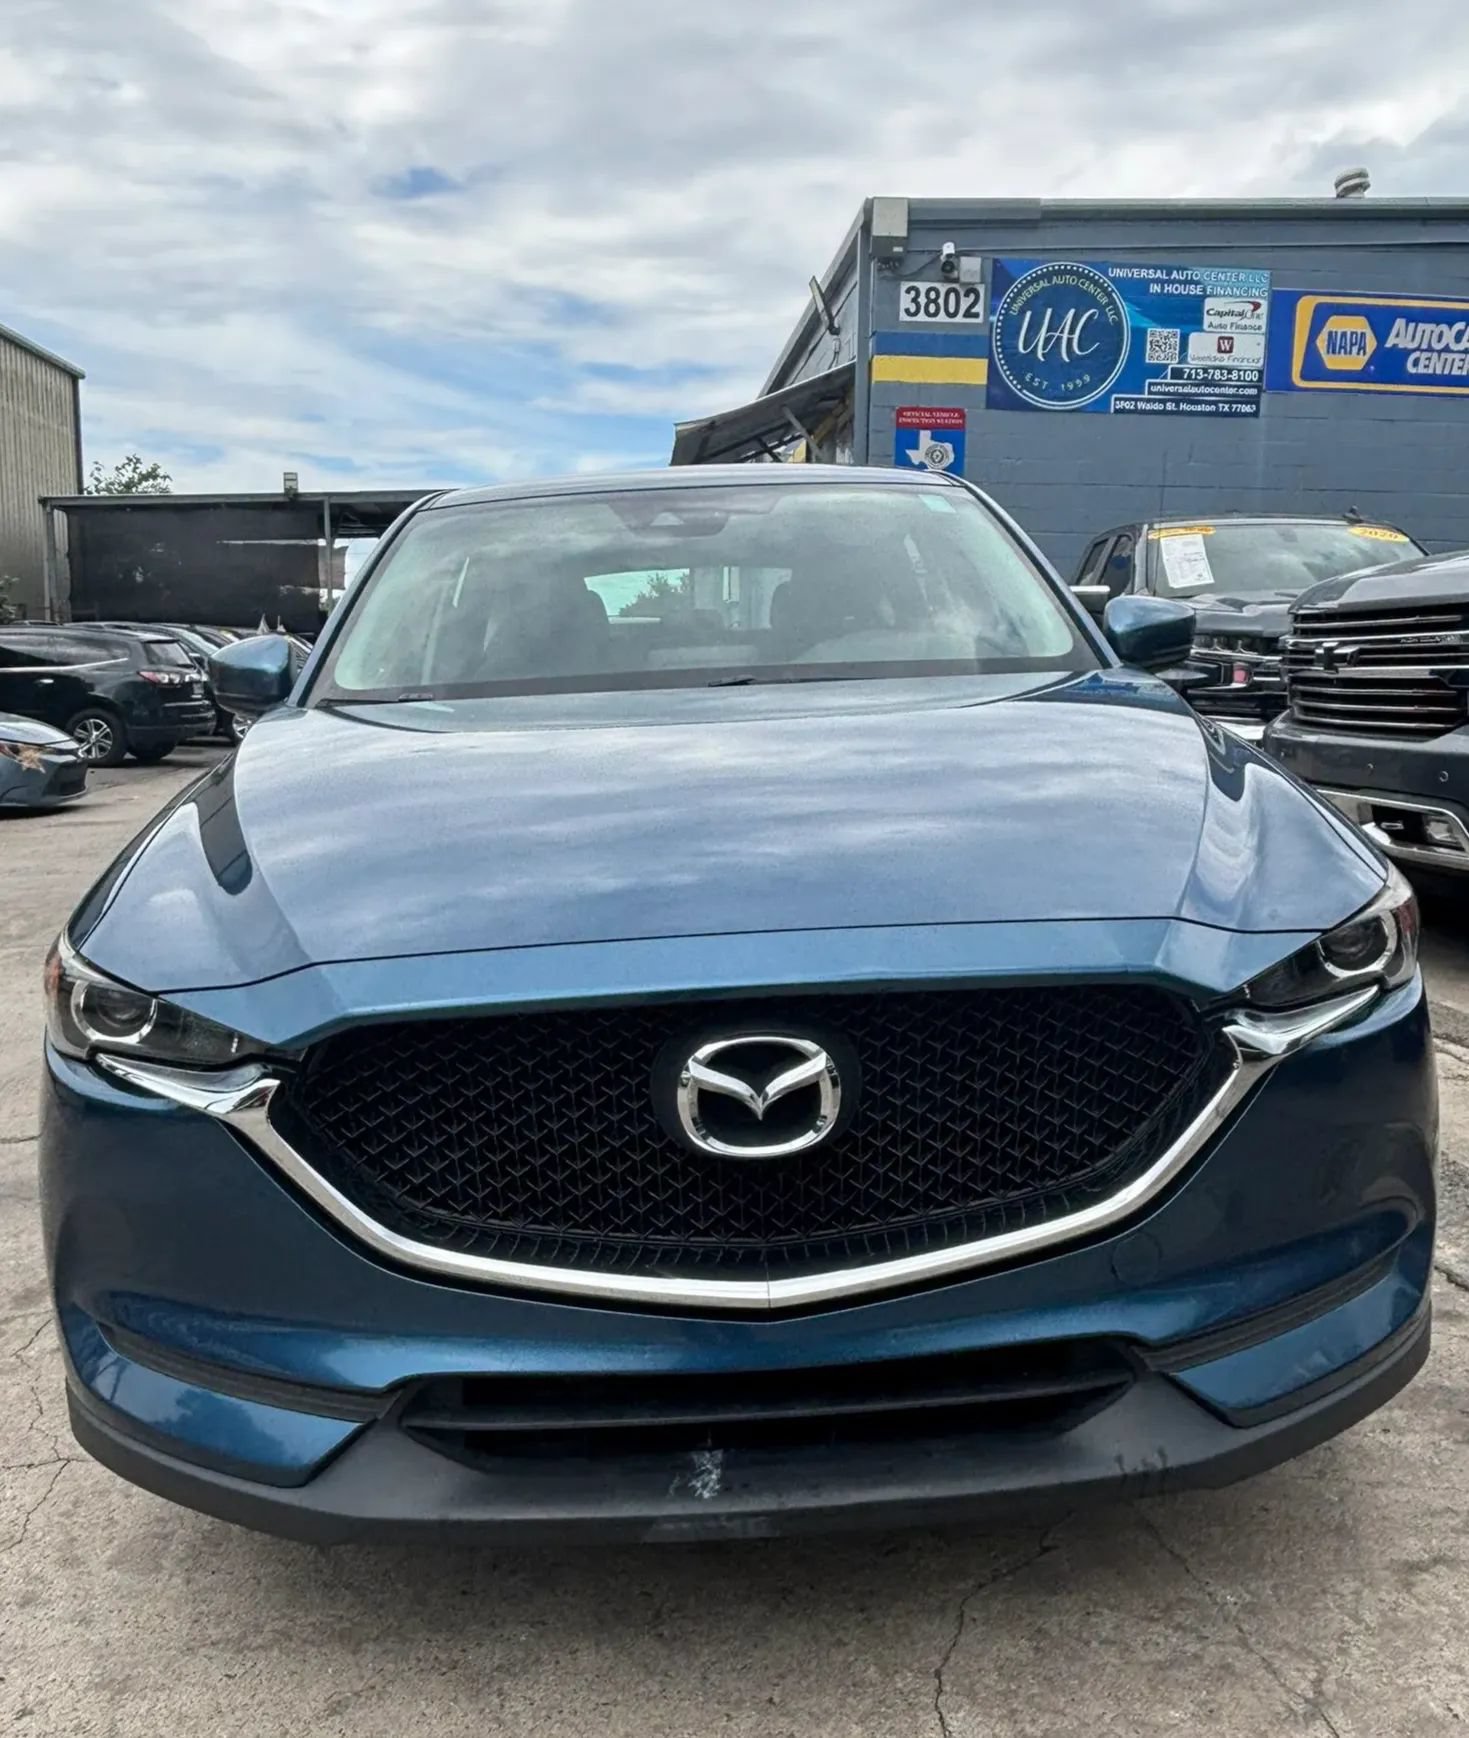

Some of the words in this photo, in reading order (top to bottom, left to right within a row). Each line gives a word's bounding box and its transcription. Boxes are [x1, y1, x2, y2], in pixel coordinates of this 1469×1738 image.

[1108, 267, 1169, 280] UNIVERSAL
[1171, 269, 1200, 281] AUTO
[1203, 271, 1246, 283] CENTER
[1249, 272, 1269, 284] LLC
[1150, 282, 1161, 294] IN
[1164, 284, 1204, 295] HOUSE
[1206, 286, 1269, 297] FINANCING
[904, 285, 981, 319] 3802
[1009, 278, 1052, 316] UNIVERSAL
[1052, 275, 1078, 286] AUTO
[1078, 278, 1109, 306] CENTER
[1105, 304, 1119, 326] LLC
[1018, 308, 1100, 362] UAC
[1208, 321, 1228, 330] Auto
[1230, 321, 1262, 331] Finance
[1384, 317, 1469, 351] AUTOC
[1326, 330, 1367, 356] NAPA
[1025, 372, 1048, 390] EST
[1183, 368, 1259, 381] 713-783-8100
[1180, 402, 1216, 412] Houston
[1218, 403, 1230, 412] TX
